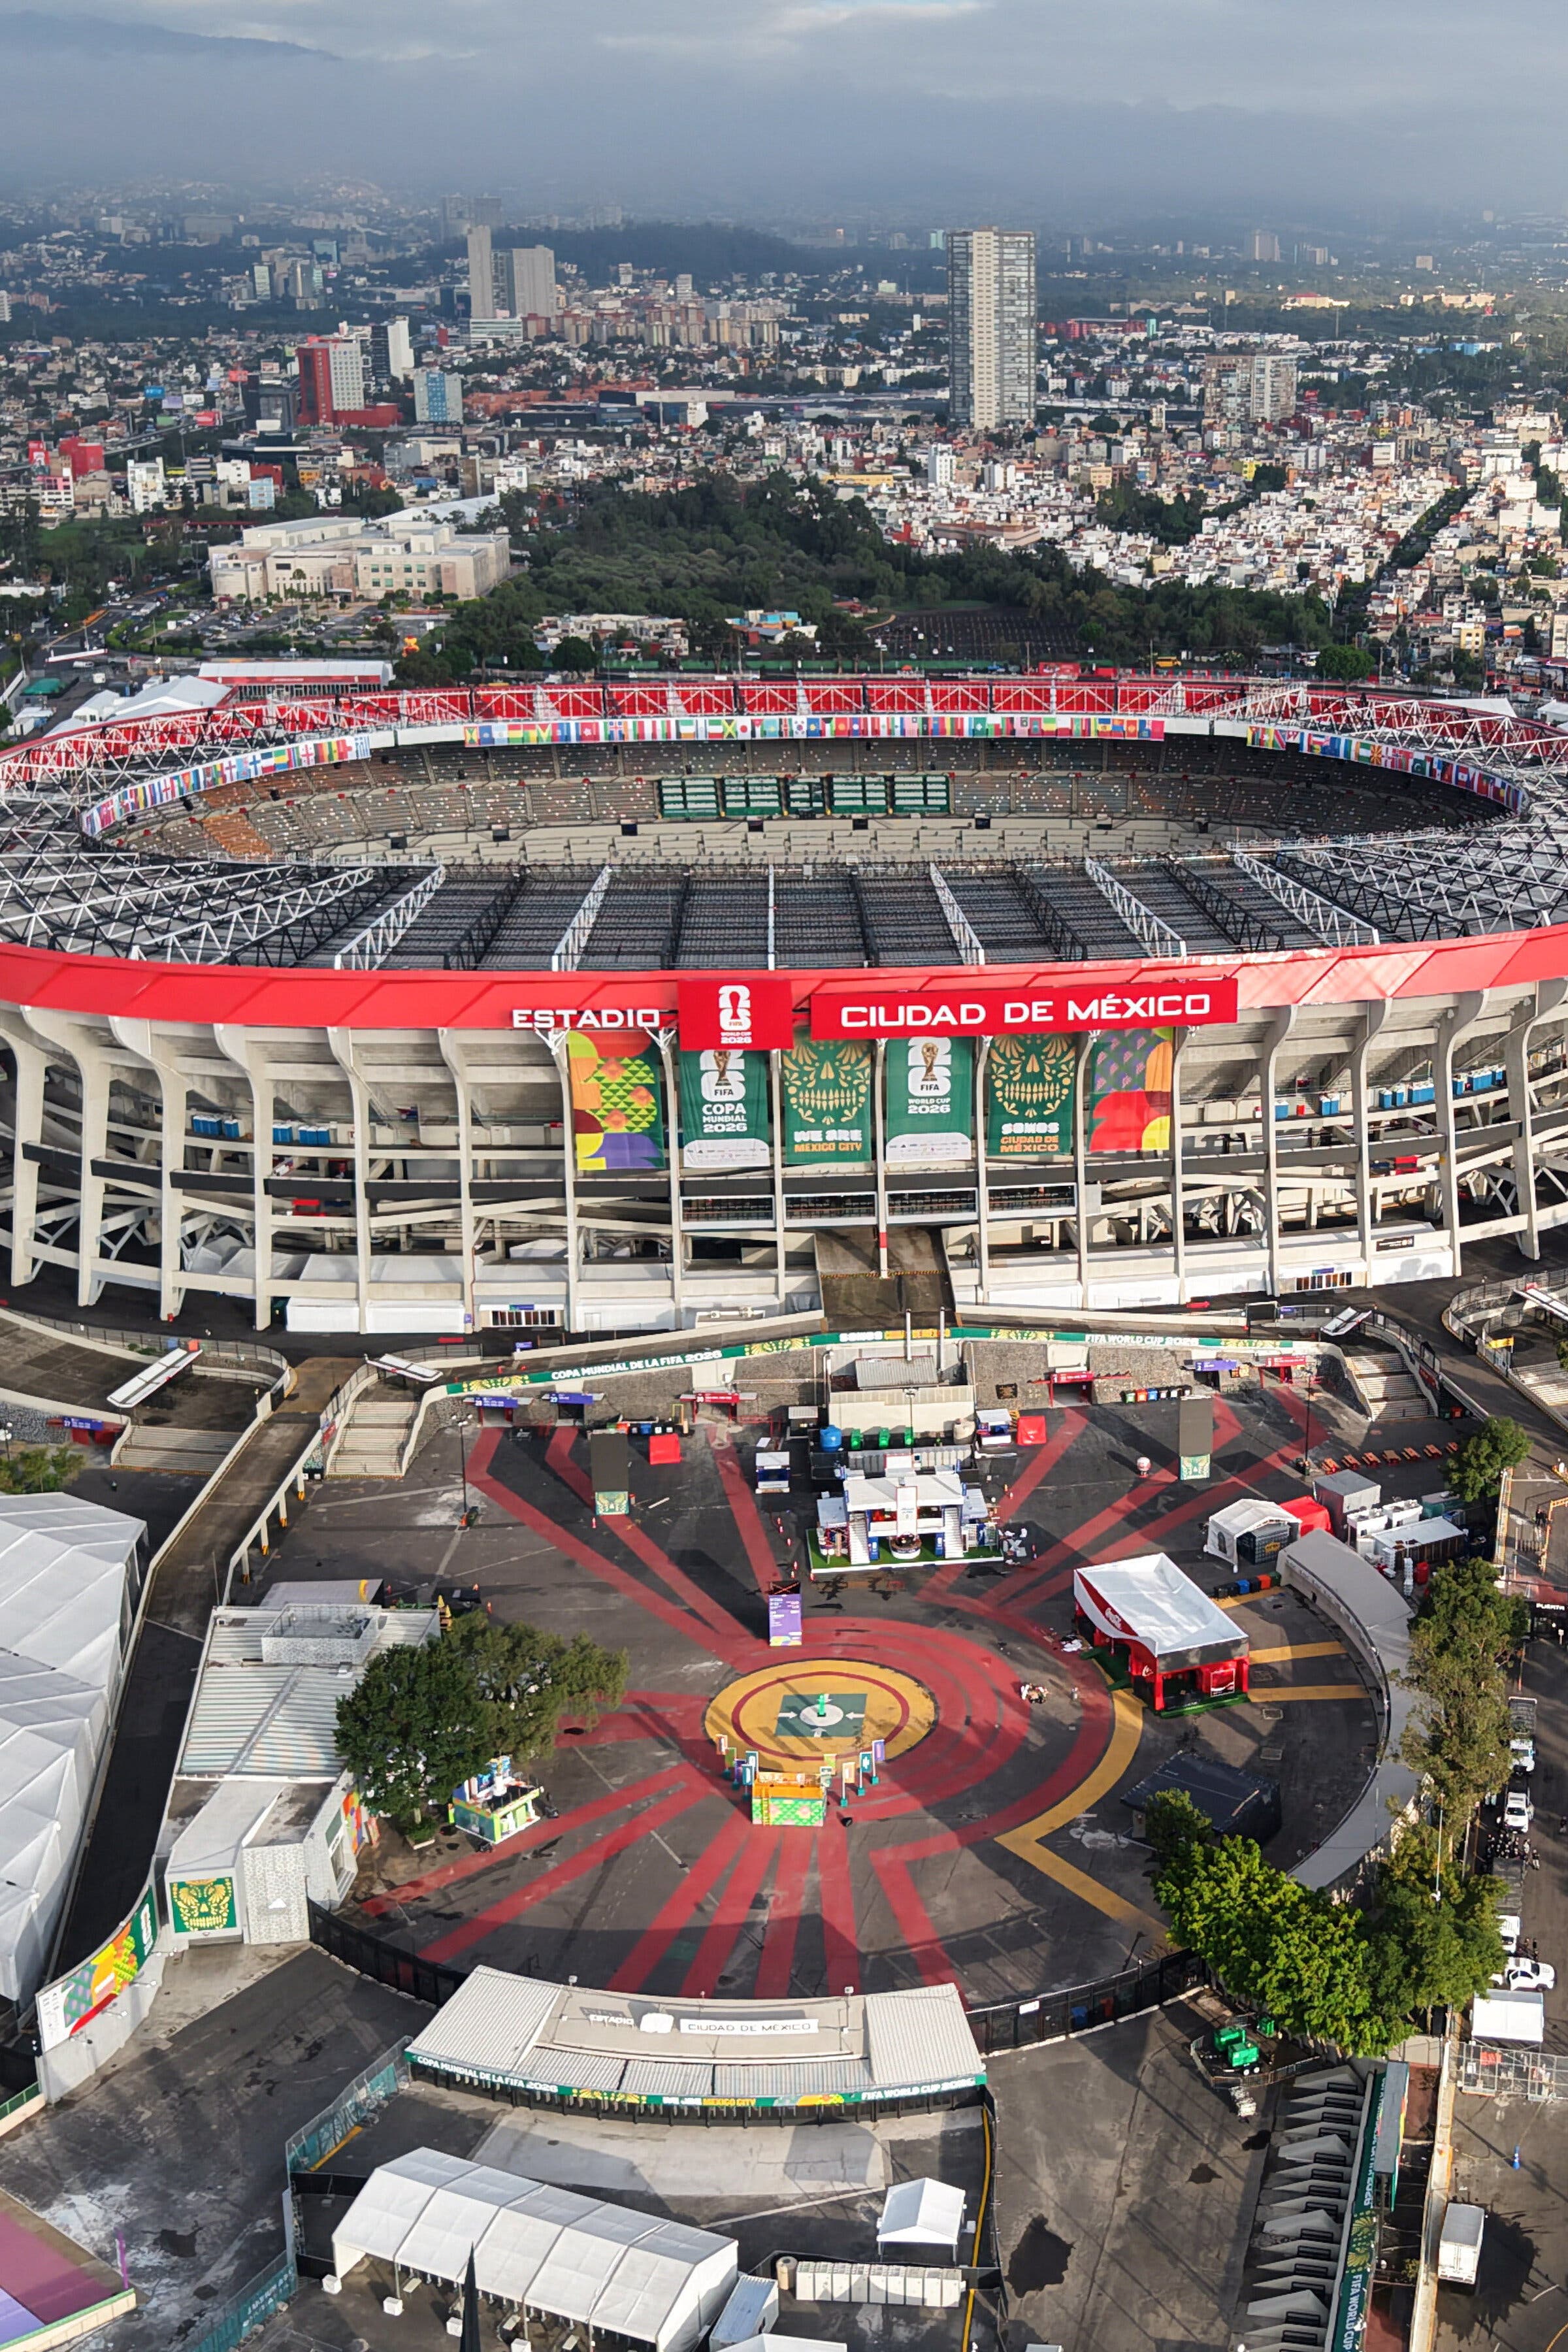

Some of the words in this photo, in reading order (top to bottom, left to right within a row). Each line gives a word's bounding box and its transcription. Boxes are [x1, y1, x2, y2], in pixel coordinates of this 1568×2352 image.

[840, 1004, 987, 1028] CIUDAD
[1004, 1000, 1054, 1024] DE
[1068, 993, 1211, 1021] MÉXICO
[512, 1009, 660, 1029] ESTADIO
[702, 1103, 746, 1115] COPA
[907, 1105, 951, 1114] 2026
[703, 1123, 747, 1133] 2026
[1002, 1122, 1060, 1135] SOMOS
[794, 1130, 823, 1142] WE
[825, 1130, 862, 1141] ARE
[794, 1143, 836, 1152] MEXICO
[838, 1143, 862, 1152] CITY
[1000, 1143, 1059, 1152] MÉXICO
[1085, 1333, 1109, 1343] FIFA
[1108, 1334, 1143, 1345] WORLD
[1144, 1335, 1164, 1345] CUP
[551, 1368, 581, 1380] COPA
[581, 1362, 629, 1377] MUNDIAL
[629, 1360, 645, 1370] DE
[645, 1358, 659, 1368] LA
[660, 1356, 683, 1366] FIFA
[685, 1350, 723, 1362] 2026
[740, 2023, 757, 2032] DE
[417, 2056, 440, 2069] COPA
[440, 2062, 478, 2078] MUNDIAL
[480, 2071, 491, 2080] DE
[492, 2074, 504, 2083] LA
[504, 2076, 524, 2087] FIFA
[1350, 2274, 1363, 2296] FIFA
[1345, 2295, 1360, 2330] WORLD
[1343, 2330, 1355, 2350] CUP
